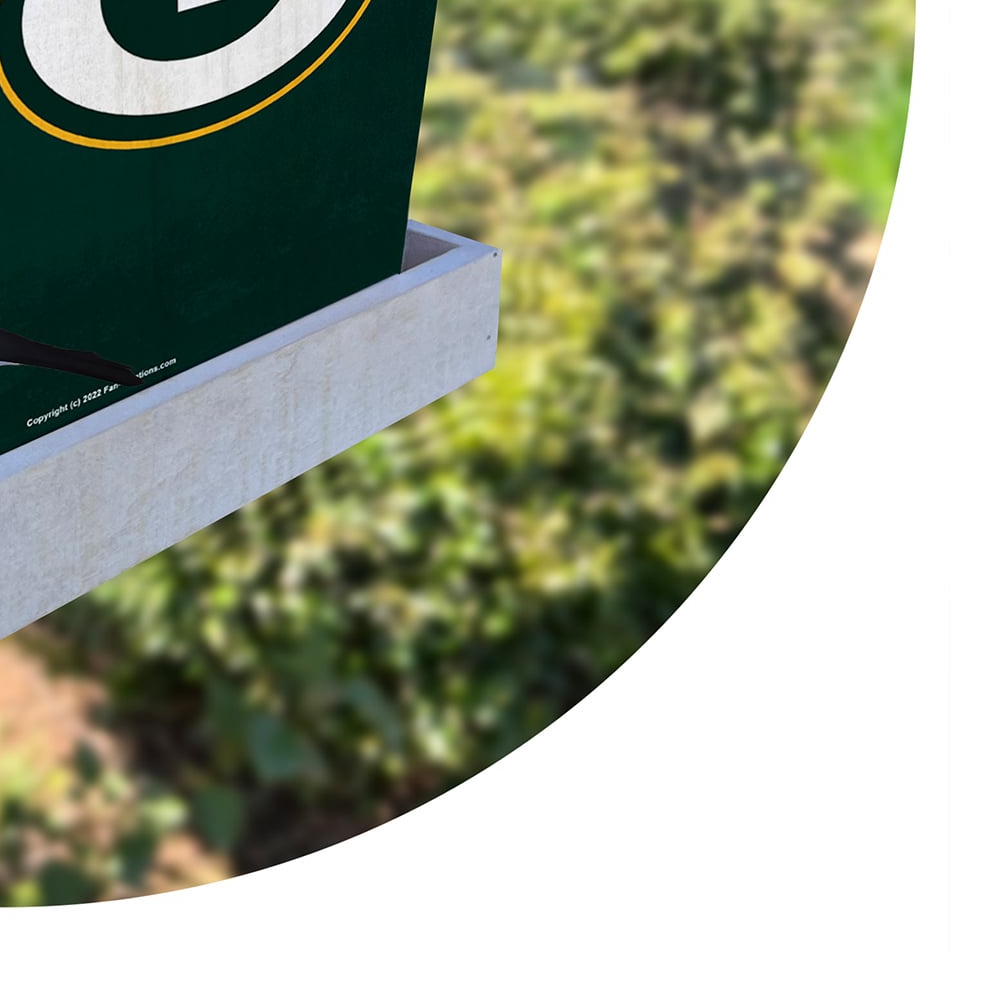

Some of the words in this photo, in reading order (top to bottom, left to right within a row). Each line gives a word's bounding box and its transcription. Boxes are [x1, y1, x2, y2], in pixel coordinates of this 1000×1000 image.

[26, 403, 69, 427] Copyright
[69, 398, 81, 411] (c)
[82, 388, 102, 404] 2022
